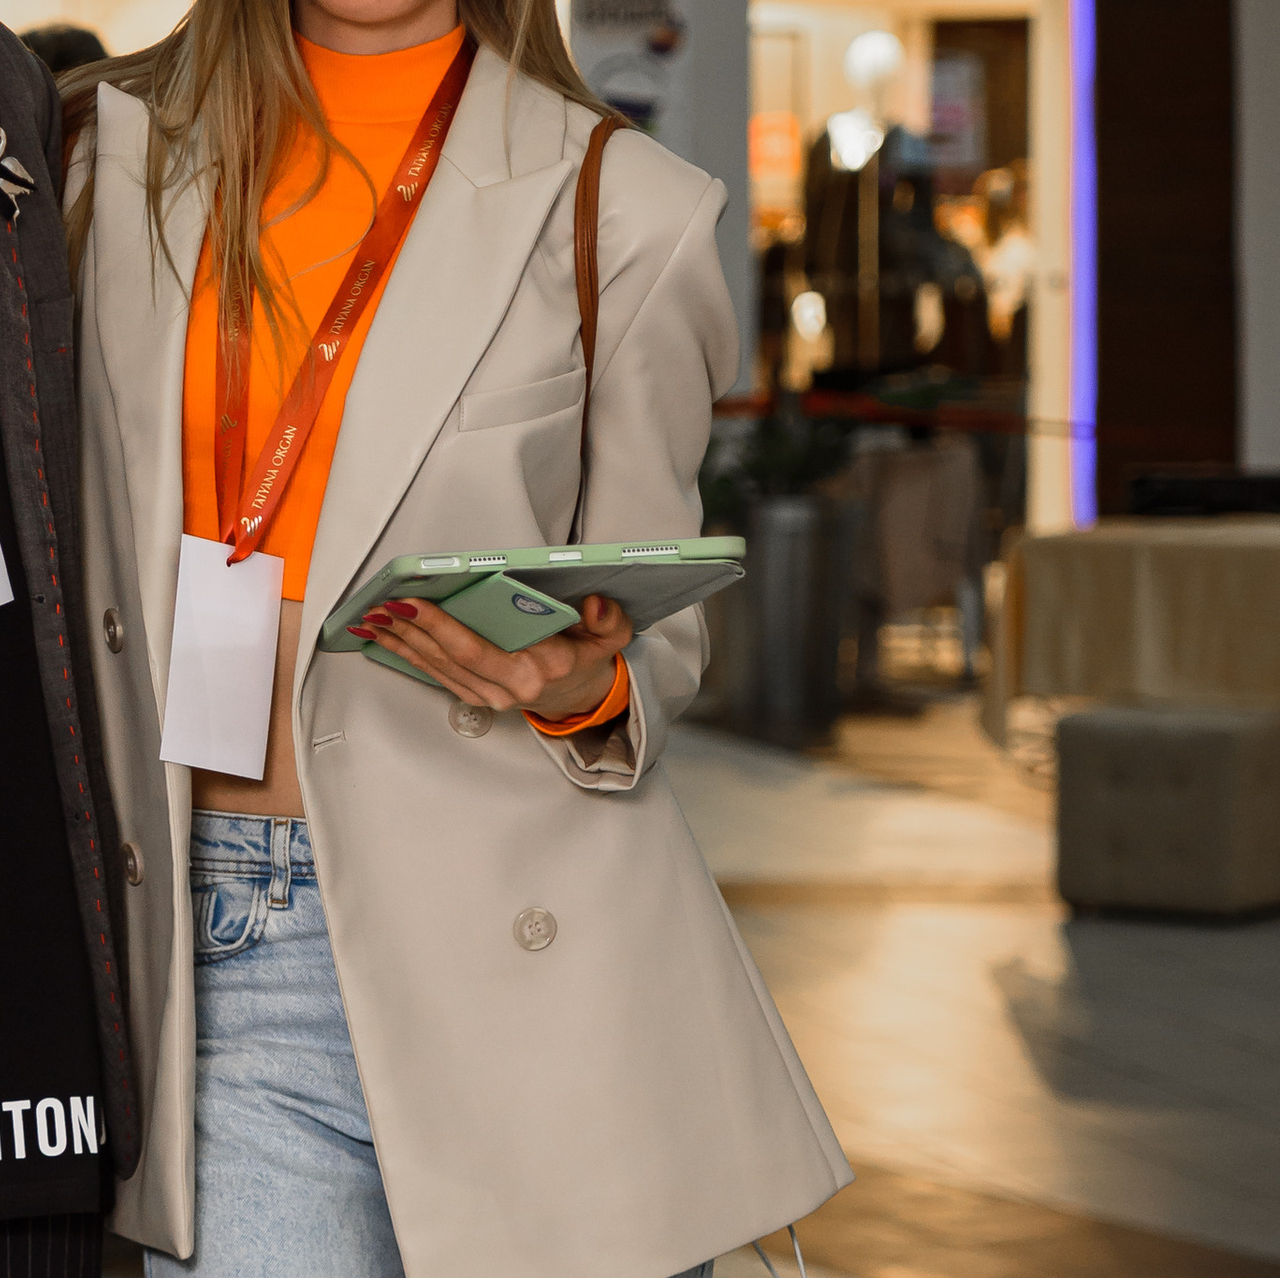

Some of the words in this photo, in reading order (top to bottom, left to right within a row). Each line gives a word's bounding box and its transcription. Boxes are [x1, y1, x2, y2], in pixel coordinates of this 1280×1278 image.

[408, 139, 435, 177] TATYANA
[329, 298, 357, 335] TATYANA
[350, 259, 375, 296] ORGAN
[251, 469, 279, 510] TATYANA
[271, 425, 298, 467] ORGAN
